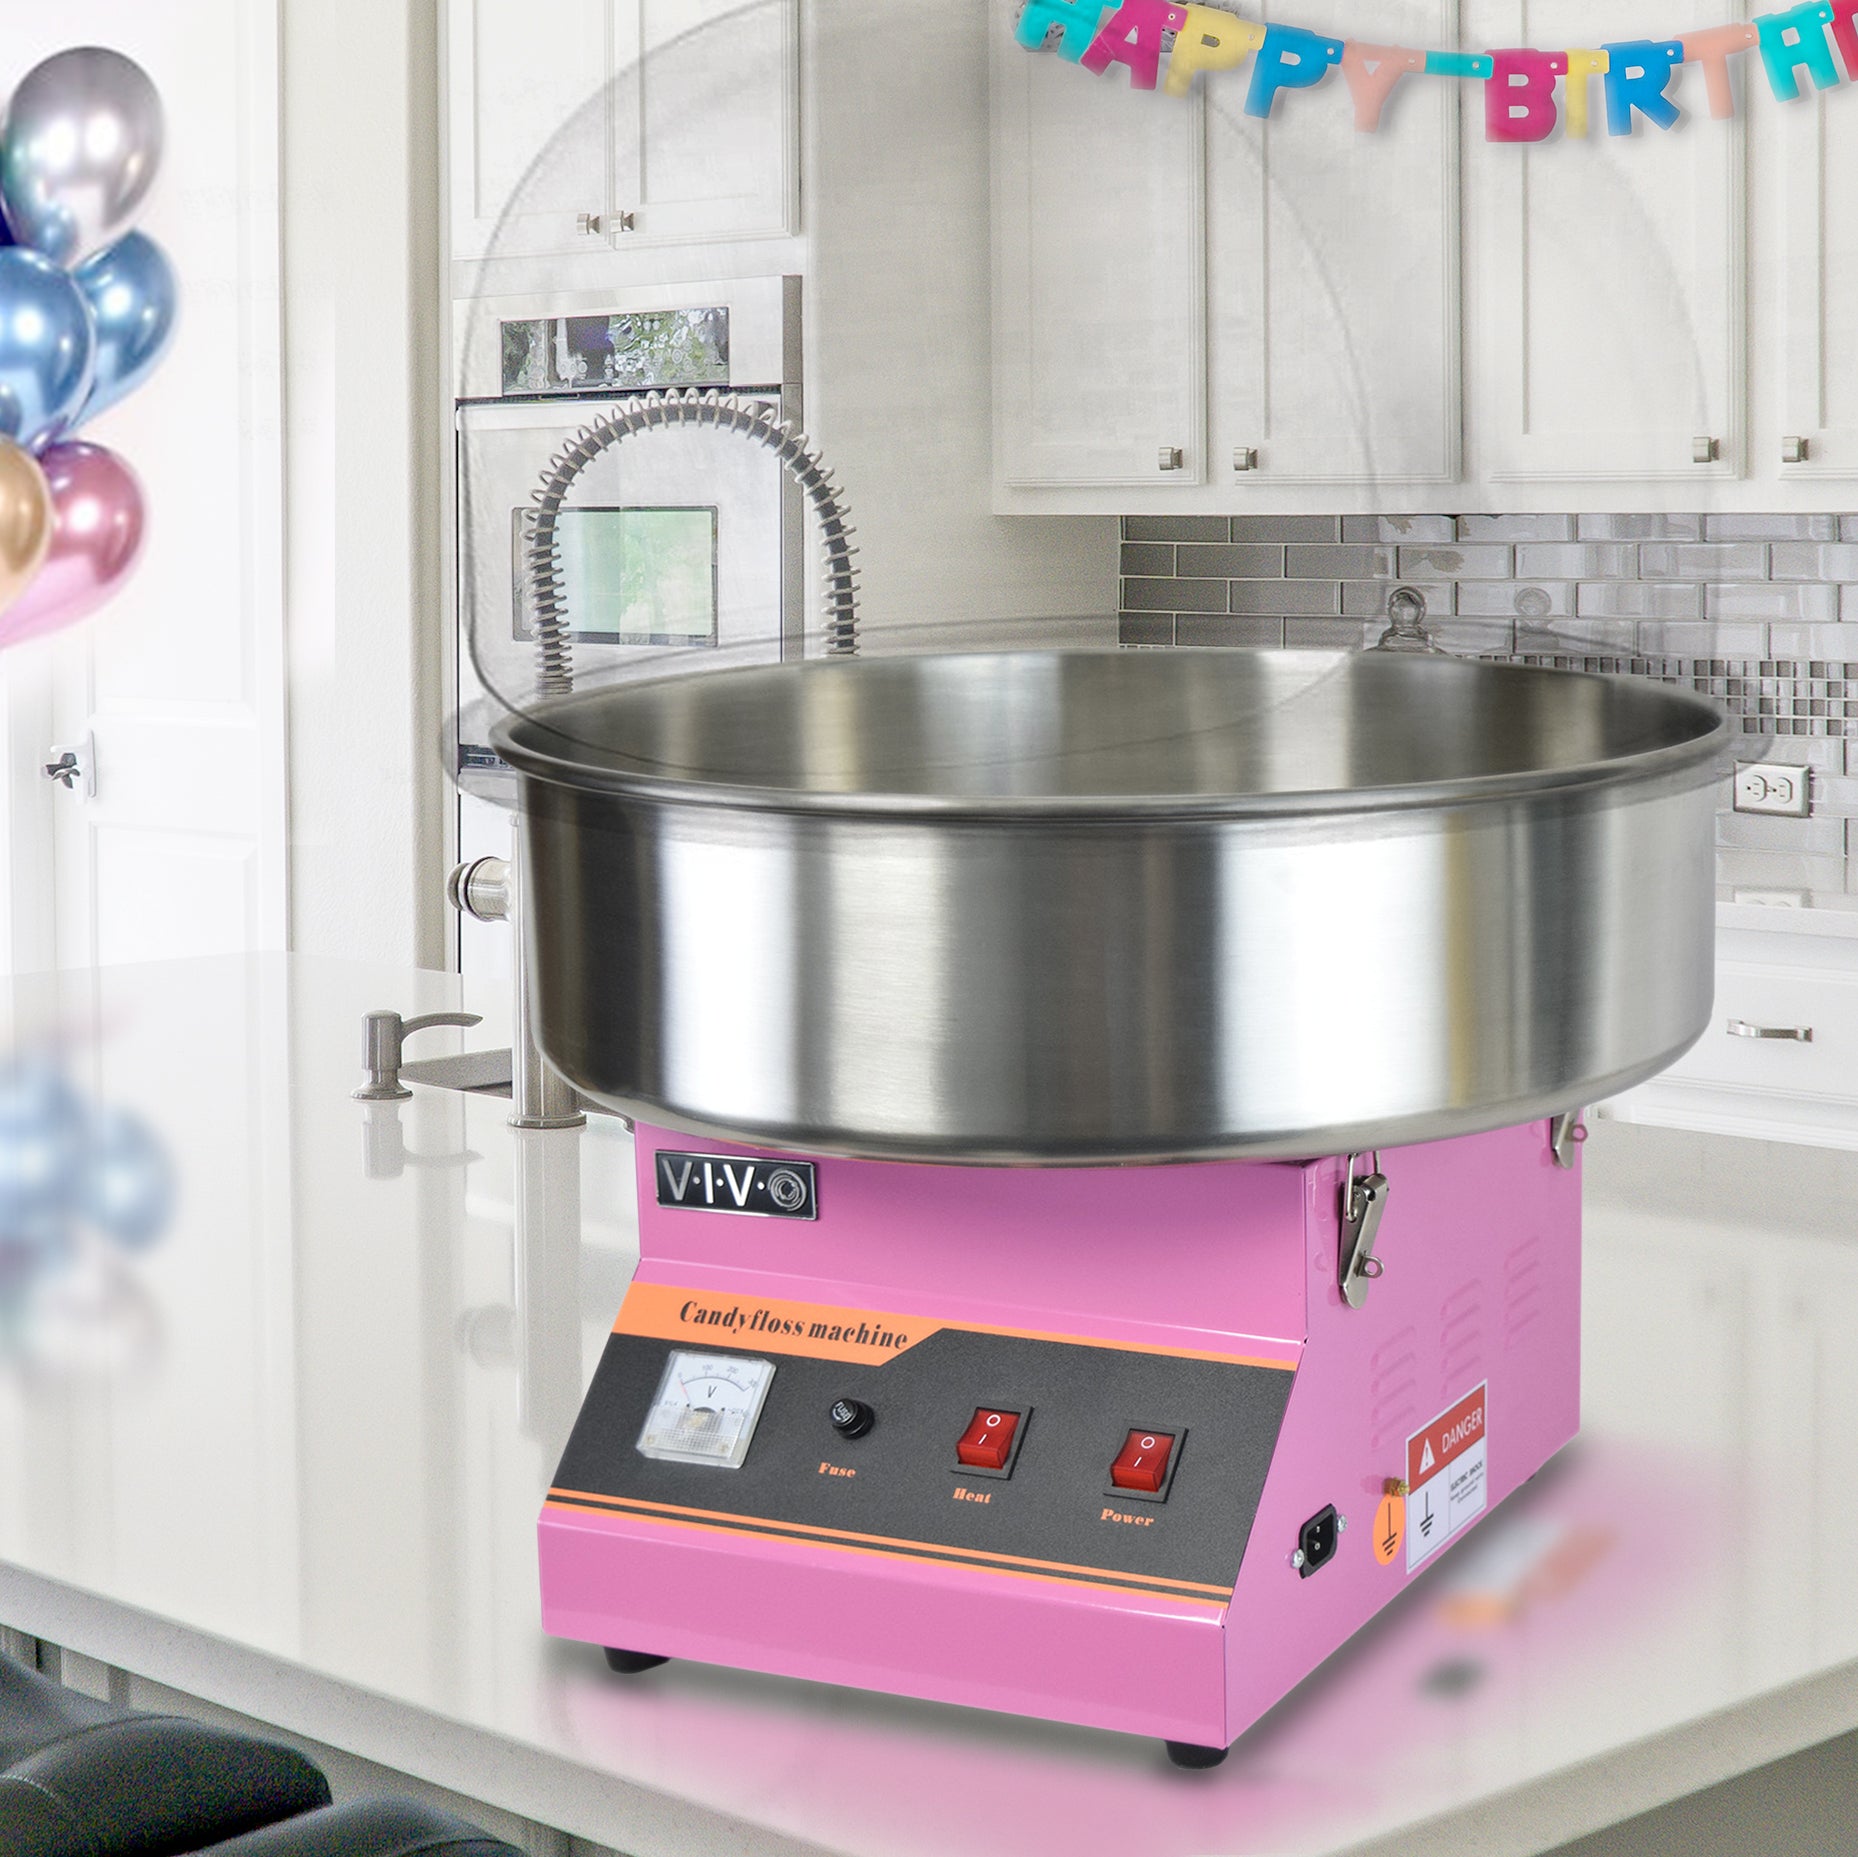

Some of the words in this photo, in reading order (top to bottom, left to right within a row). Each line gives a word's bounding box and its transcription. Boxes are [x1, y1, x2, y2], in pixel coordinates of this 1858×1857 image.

[1014, 0, 1414, 133] HAPPY
[680, 1300, 805, 1336] Candyfloss
[808, 1322, 908, 1350] machine
[707, 1385, 717, 1398] V
[1442, 1407, 1483, 1454] DANGER
[818, 1462, 856, 1478] Fuse
[952, 1487, 992, 1504] Heat
[1100, 1508, 1155, 1527] Power
